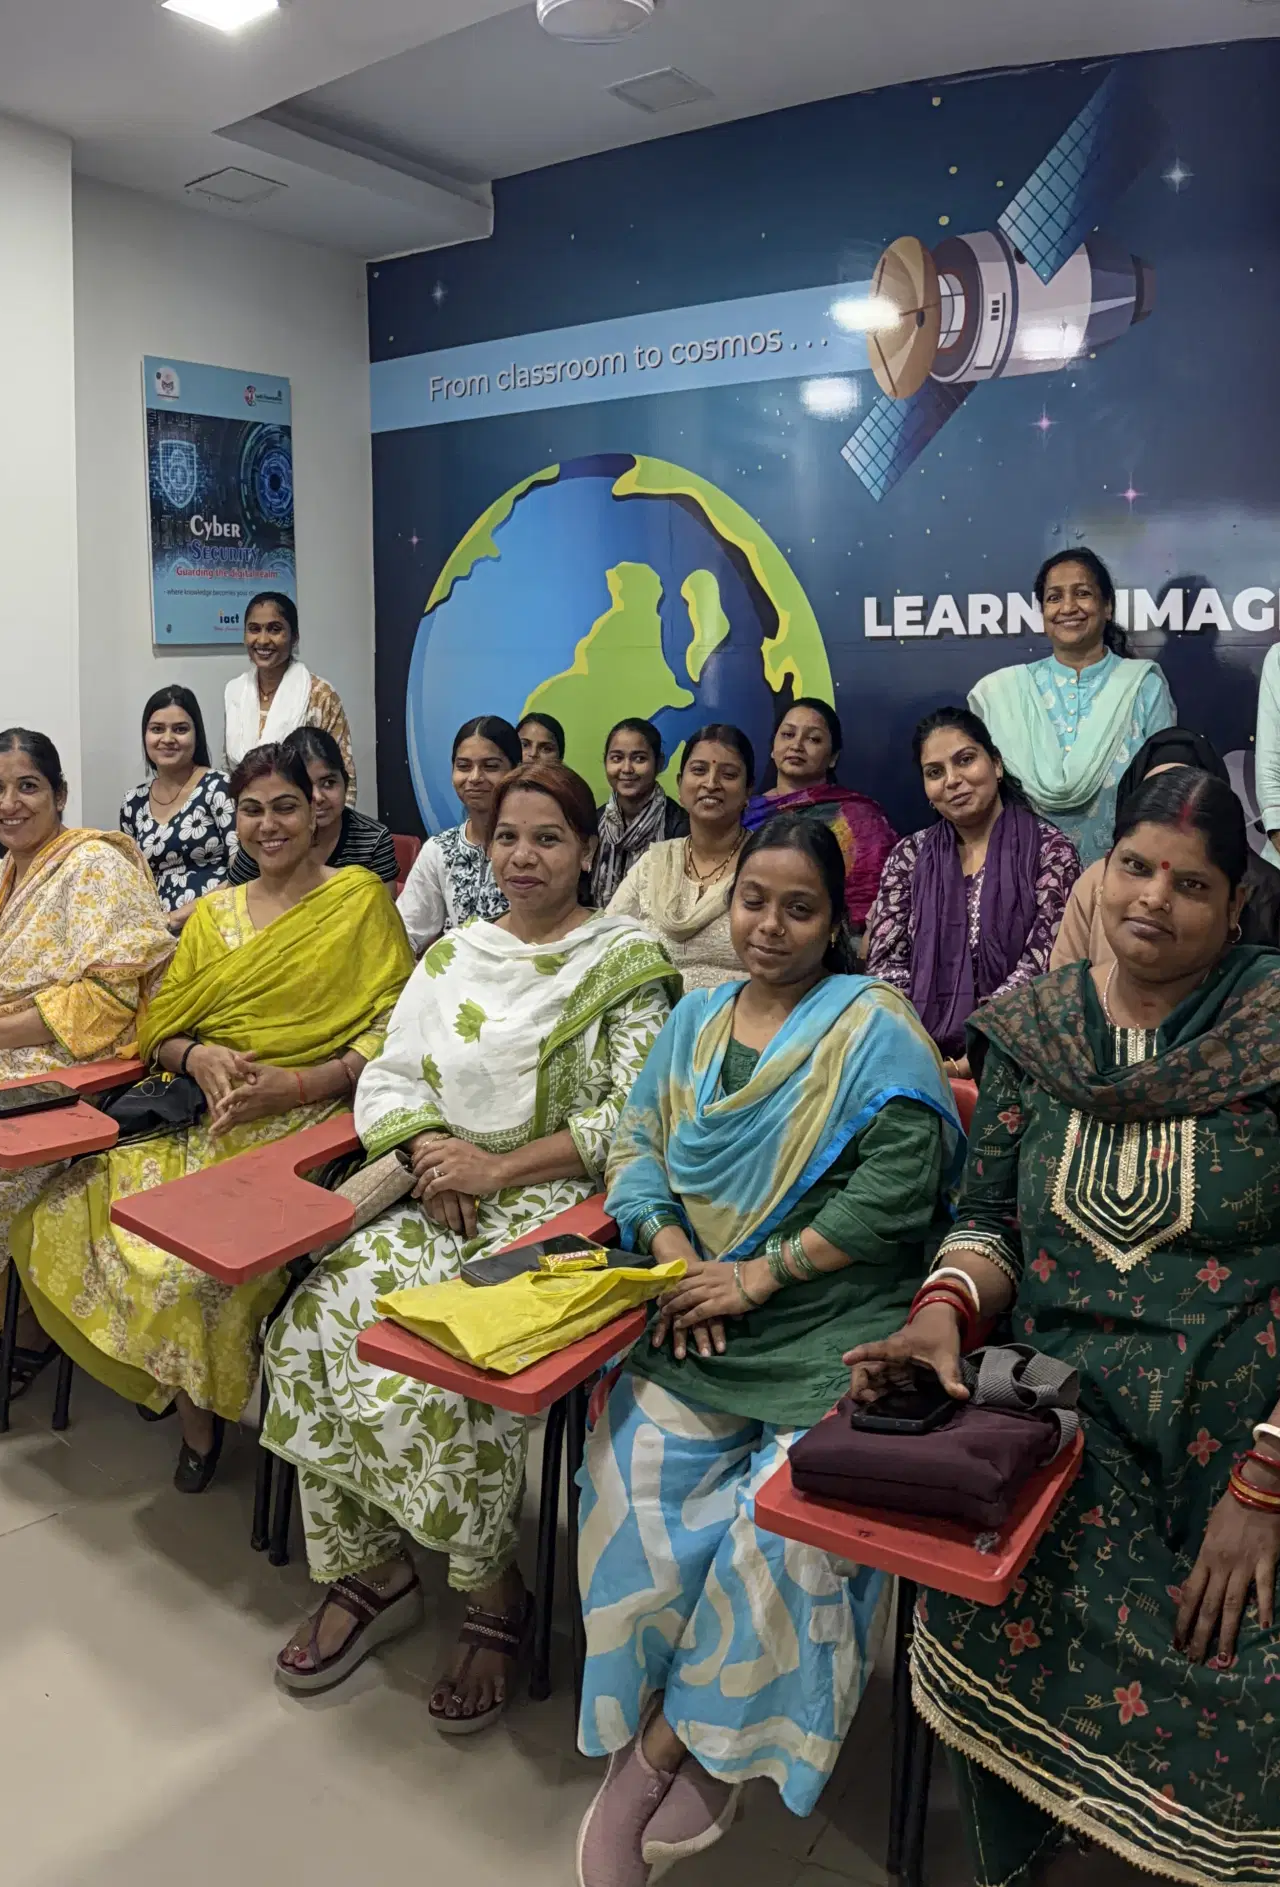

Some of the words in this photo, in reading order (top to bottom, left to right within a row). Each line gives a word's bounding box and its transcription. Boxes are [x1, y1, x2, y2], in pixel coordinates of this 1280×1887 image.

[429, 374, 490, 401] From
[496, 351, 626, 390] classroom
[634, 343, 663, 371] to
[669, 327, 783, 366] cosmos
[176, 566, 213, 579] Guarding
[215, 568, 227, 577] the
[229, 568, 257, 579] digital
[258, 570, 278, 578] realm
[219, 608, 239, 624] iact
[864, 592, 1045, 637] LEARN
